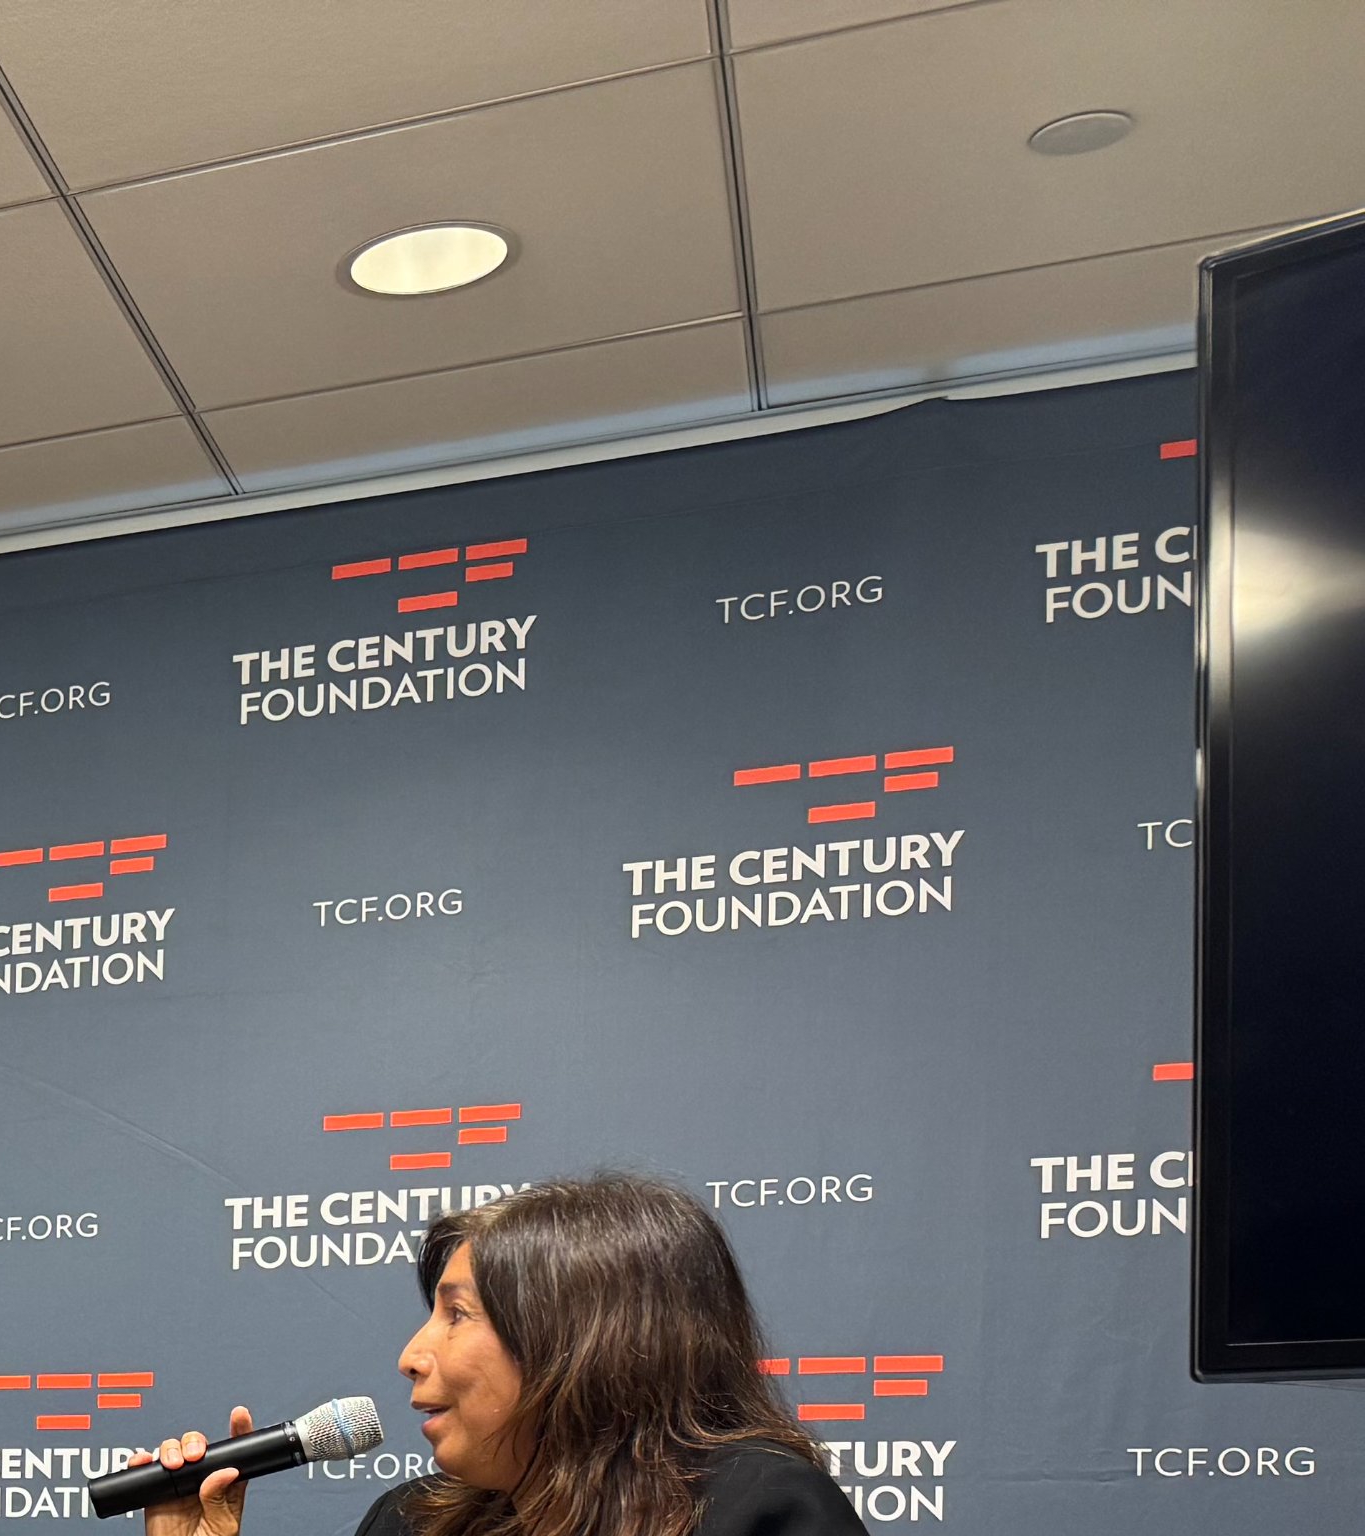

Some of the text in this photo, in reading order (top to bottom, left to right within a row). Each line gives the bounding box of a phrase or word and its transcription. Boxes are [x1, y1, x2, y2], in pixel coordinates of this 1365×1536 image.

[1036, 533, 1139, 577] THE
[716, 576, 882, 623] TCF.ORG
[233, 615, 536, 684] THE CENTURY
[241, 658, 525, 724] FOUNDATION
[623, 830, 964, 895] THE CENTURY
[313, 889, 462, 926] TCF.ORG
[632, 876, 951, 938] FOUNDATION
[706, 1174, 872, 1208] TCF.ORG
[1031, 1154, 1134, 1193] THE
[225, 1195, 308, 1229] THE
[232, 1230, 426, 1270] FOUNDA
[820, 1440, 957, 1477] TURY
[1127, 1447, 1314, 1476] TCF.ORG
